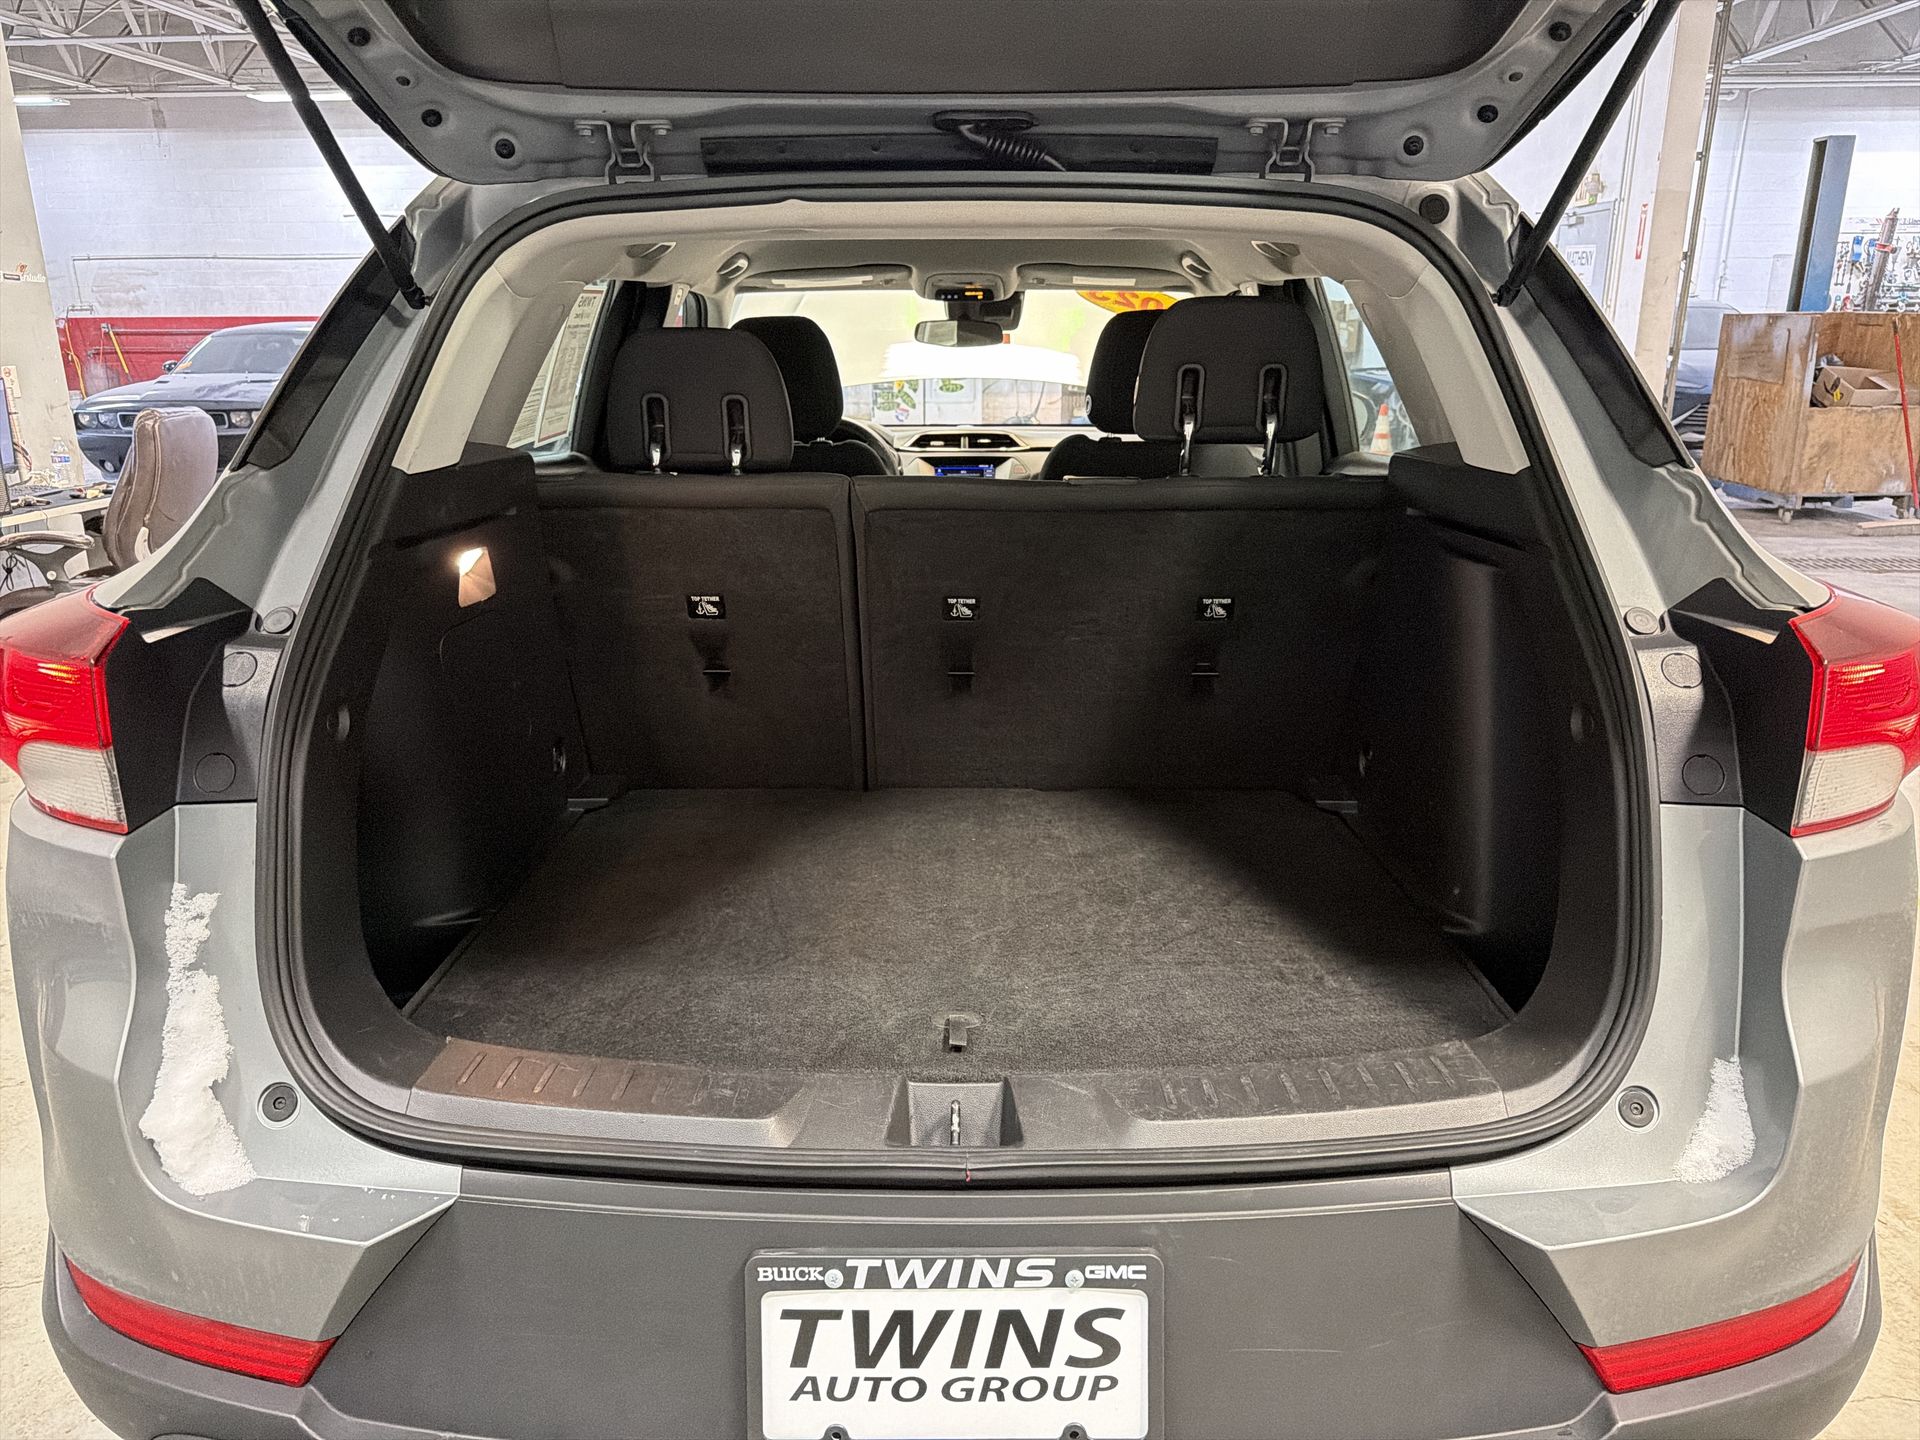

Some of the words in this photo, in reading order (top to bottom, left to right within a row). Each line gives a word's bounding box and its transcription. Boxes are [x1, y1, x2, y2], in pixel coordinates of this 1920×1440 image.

[757, 1266, 825, 1282] BUICK
[845, 1258, 1056, 1289] TWINS
[1084, 1264, 1147, 1280] GMC
[779, 1307, 1126, 1369] TWINS
[788, 1375, 928, 1402] AUTO
[941, 1375, 1119, 1402] GROUP
